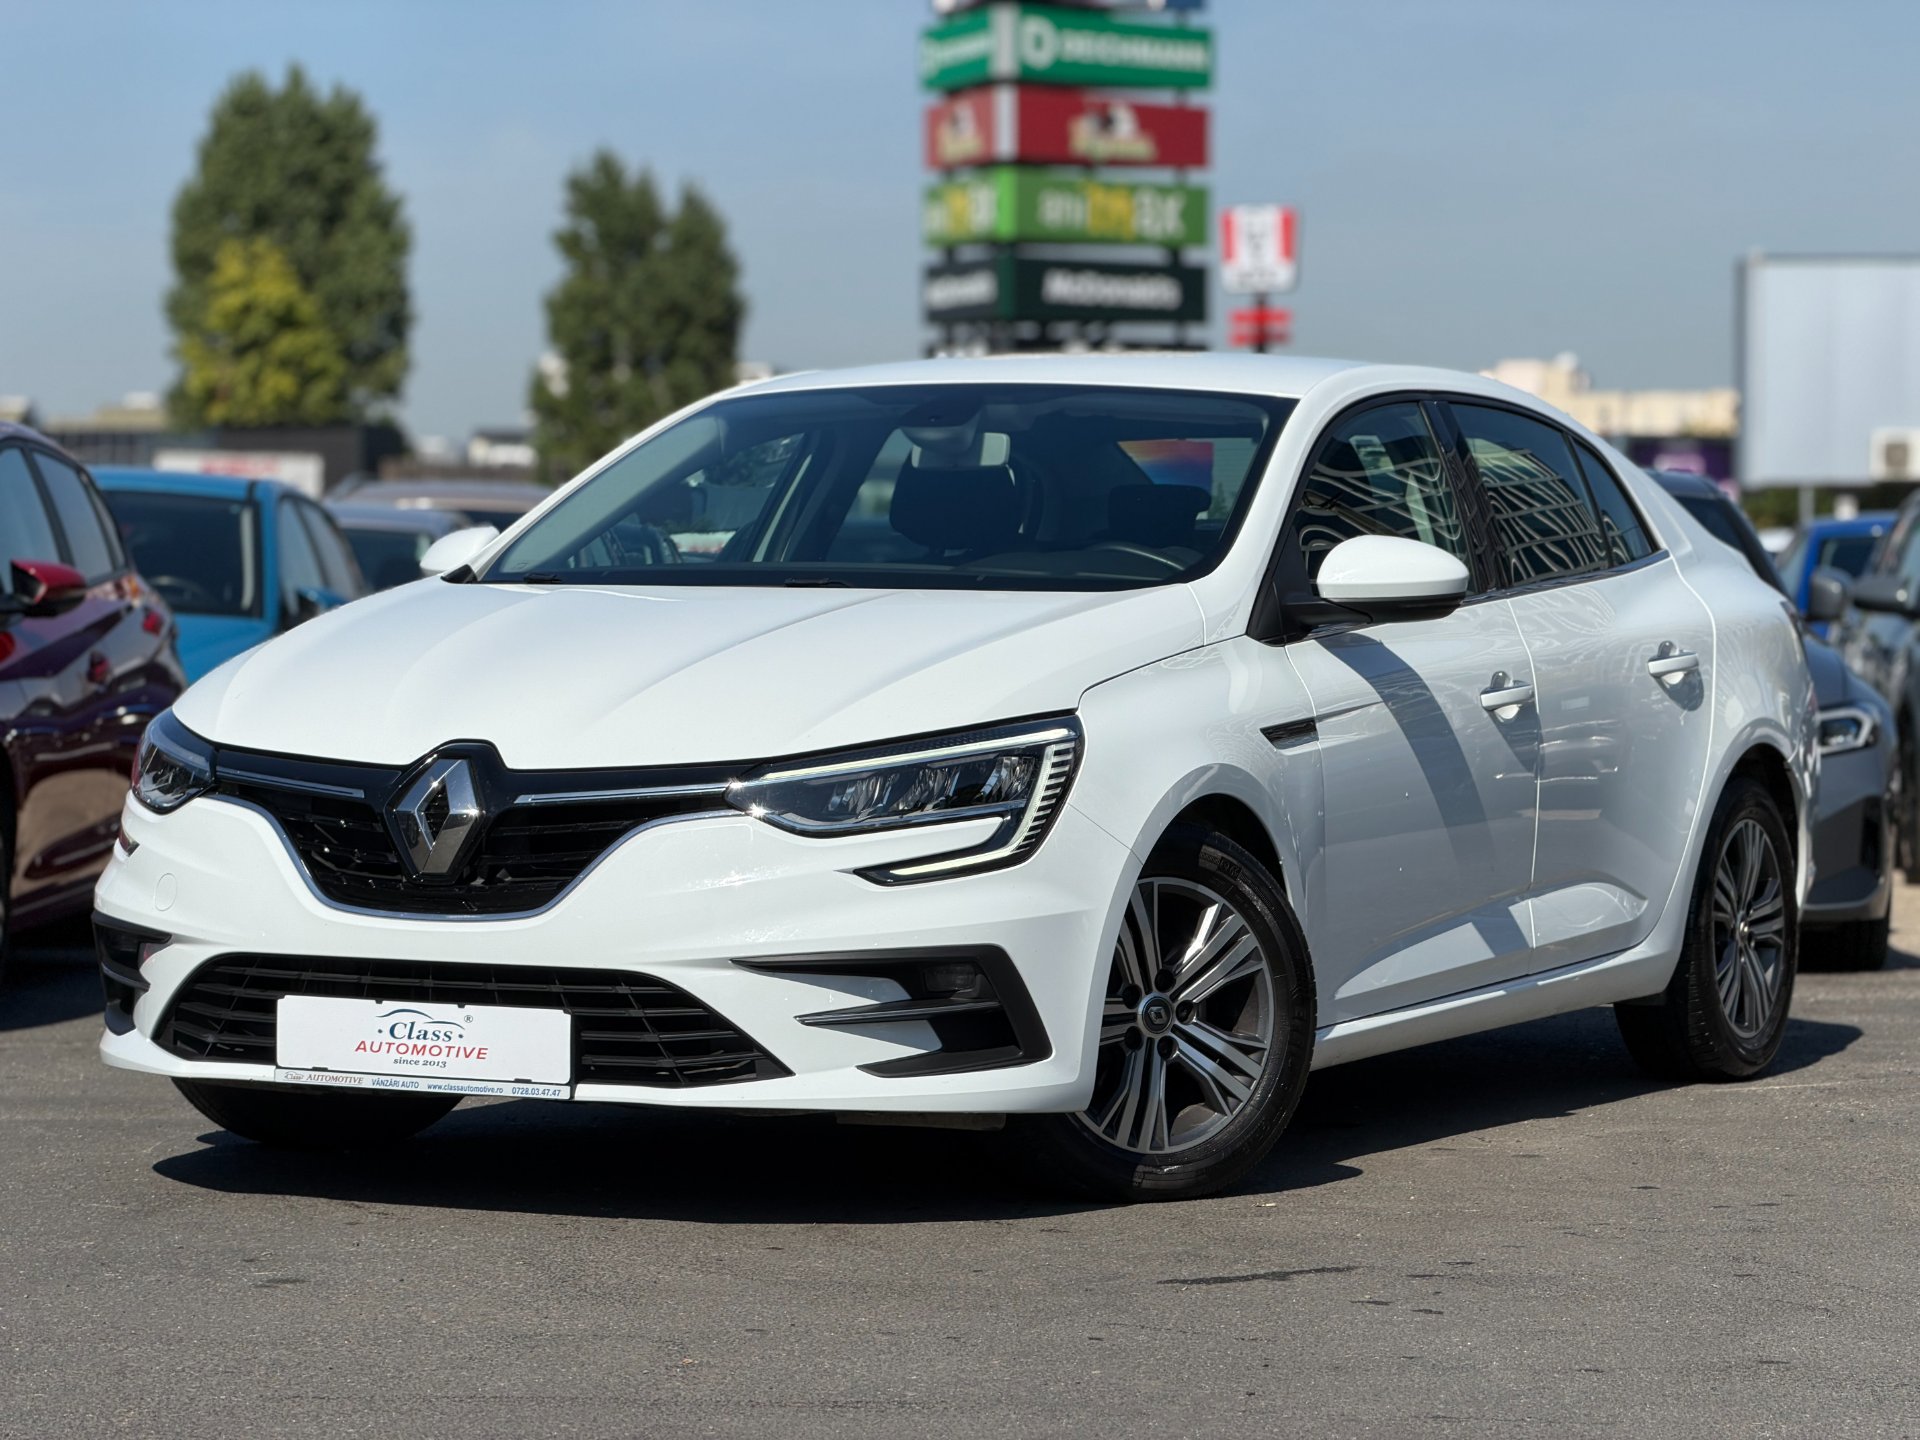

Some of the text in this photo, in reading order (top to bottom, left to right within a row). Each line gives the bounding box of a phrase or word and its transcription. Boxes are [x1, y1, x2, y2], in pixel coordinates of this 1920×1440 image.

[389, 1020, 453, 1042] Class
[355, 1040, 489, 1060] AUTOMOTIVE
[393, 1056, 447, 1068] since 2013
[306, 1073, 364, 1085] AUTOMOTIVE
[401, 1080, 419, 1089] AUTO
[427, 1082, 504, 1094] www.classautomotive.ro
[511, 1086, 562, 1097] 0728.03.47.47
